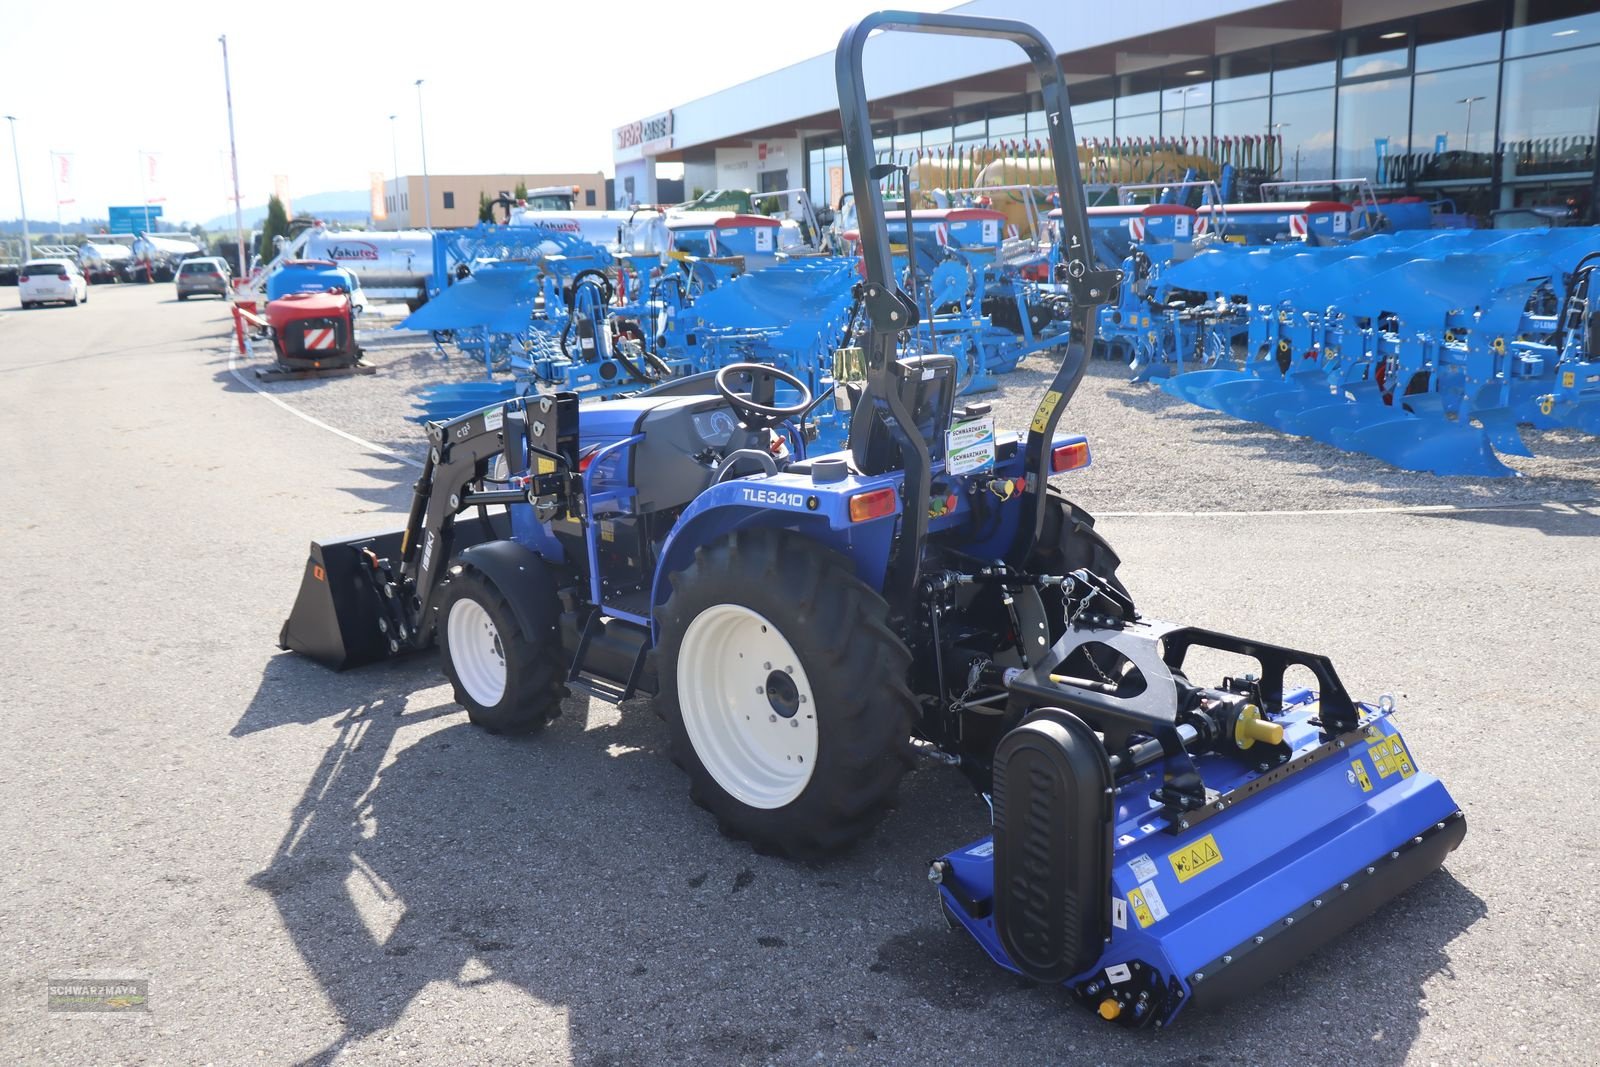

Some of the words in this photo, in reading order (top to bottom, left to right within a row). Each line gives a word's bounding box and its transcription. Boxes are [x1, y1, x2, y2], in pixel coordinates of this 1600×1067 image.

[327, 246, 378, 259] Vakutec
[953, 425, 986, 436] SCHWARZMAYR
[953, 449, 987, 461] SCHWARZMAYR
[742, 488, 804, 507] TLE3410
